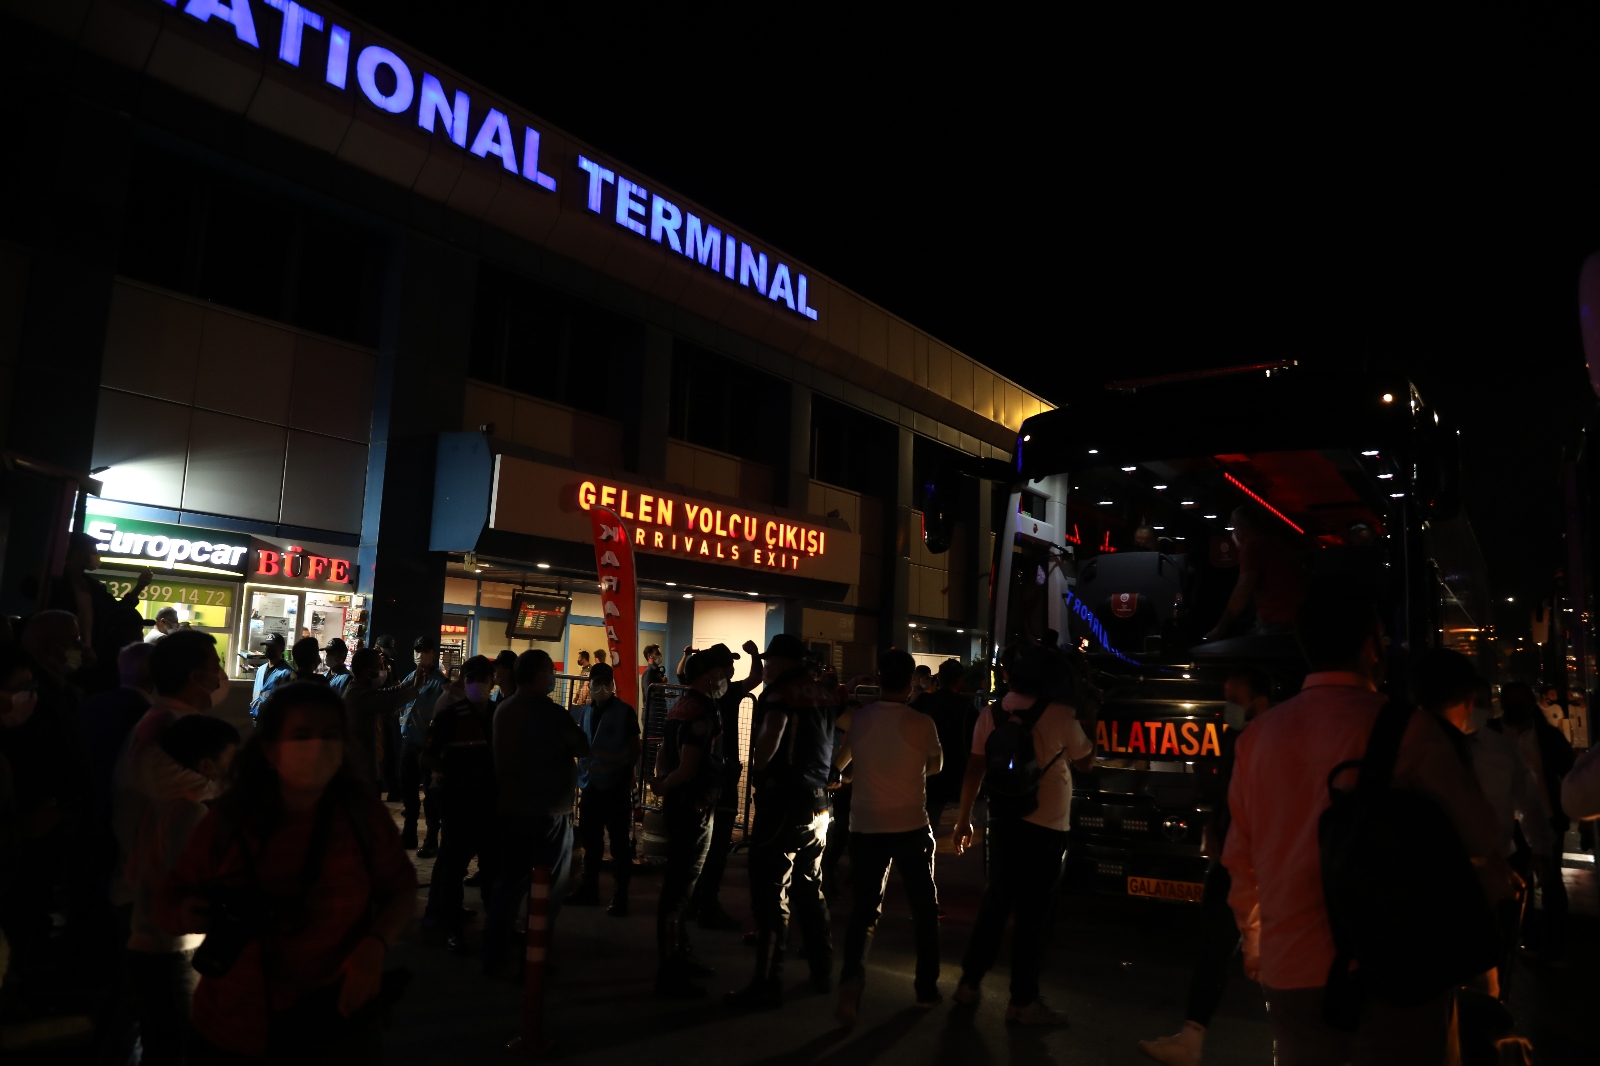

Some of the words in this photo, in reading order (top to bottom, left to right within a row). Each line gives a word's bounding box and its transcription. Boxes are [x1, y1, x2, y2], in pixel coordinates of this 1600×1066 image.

[164, 0, 557, 192] ATIONAL
[577, 154, 818, 321] TERMINAL
[578, 480, 674, 527] GELEN
[684, 502, 758, 542] YOLCU
[87, 520, 248, 569] Europcar
[255, 545, 350, 584] BÜFE
[635, 527, 740, 561] RRIVALS
[753, 548, 799, 570] EXIT
[99, 580, 132, 598] 32
[178, 587, 199, 603] 14
[204, 590, 226, 606] 72
[1096, 720, 1229, 757] ALATASA
